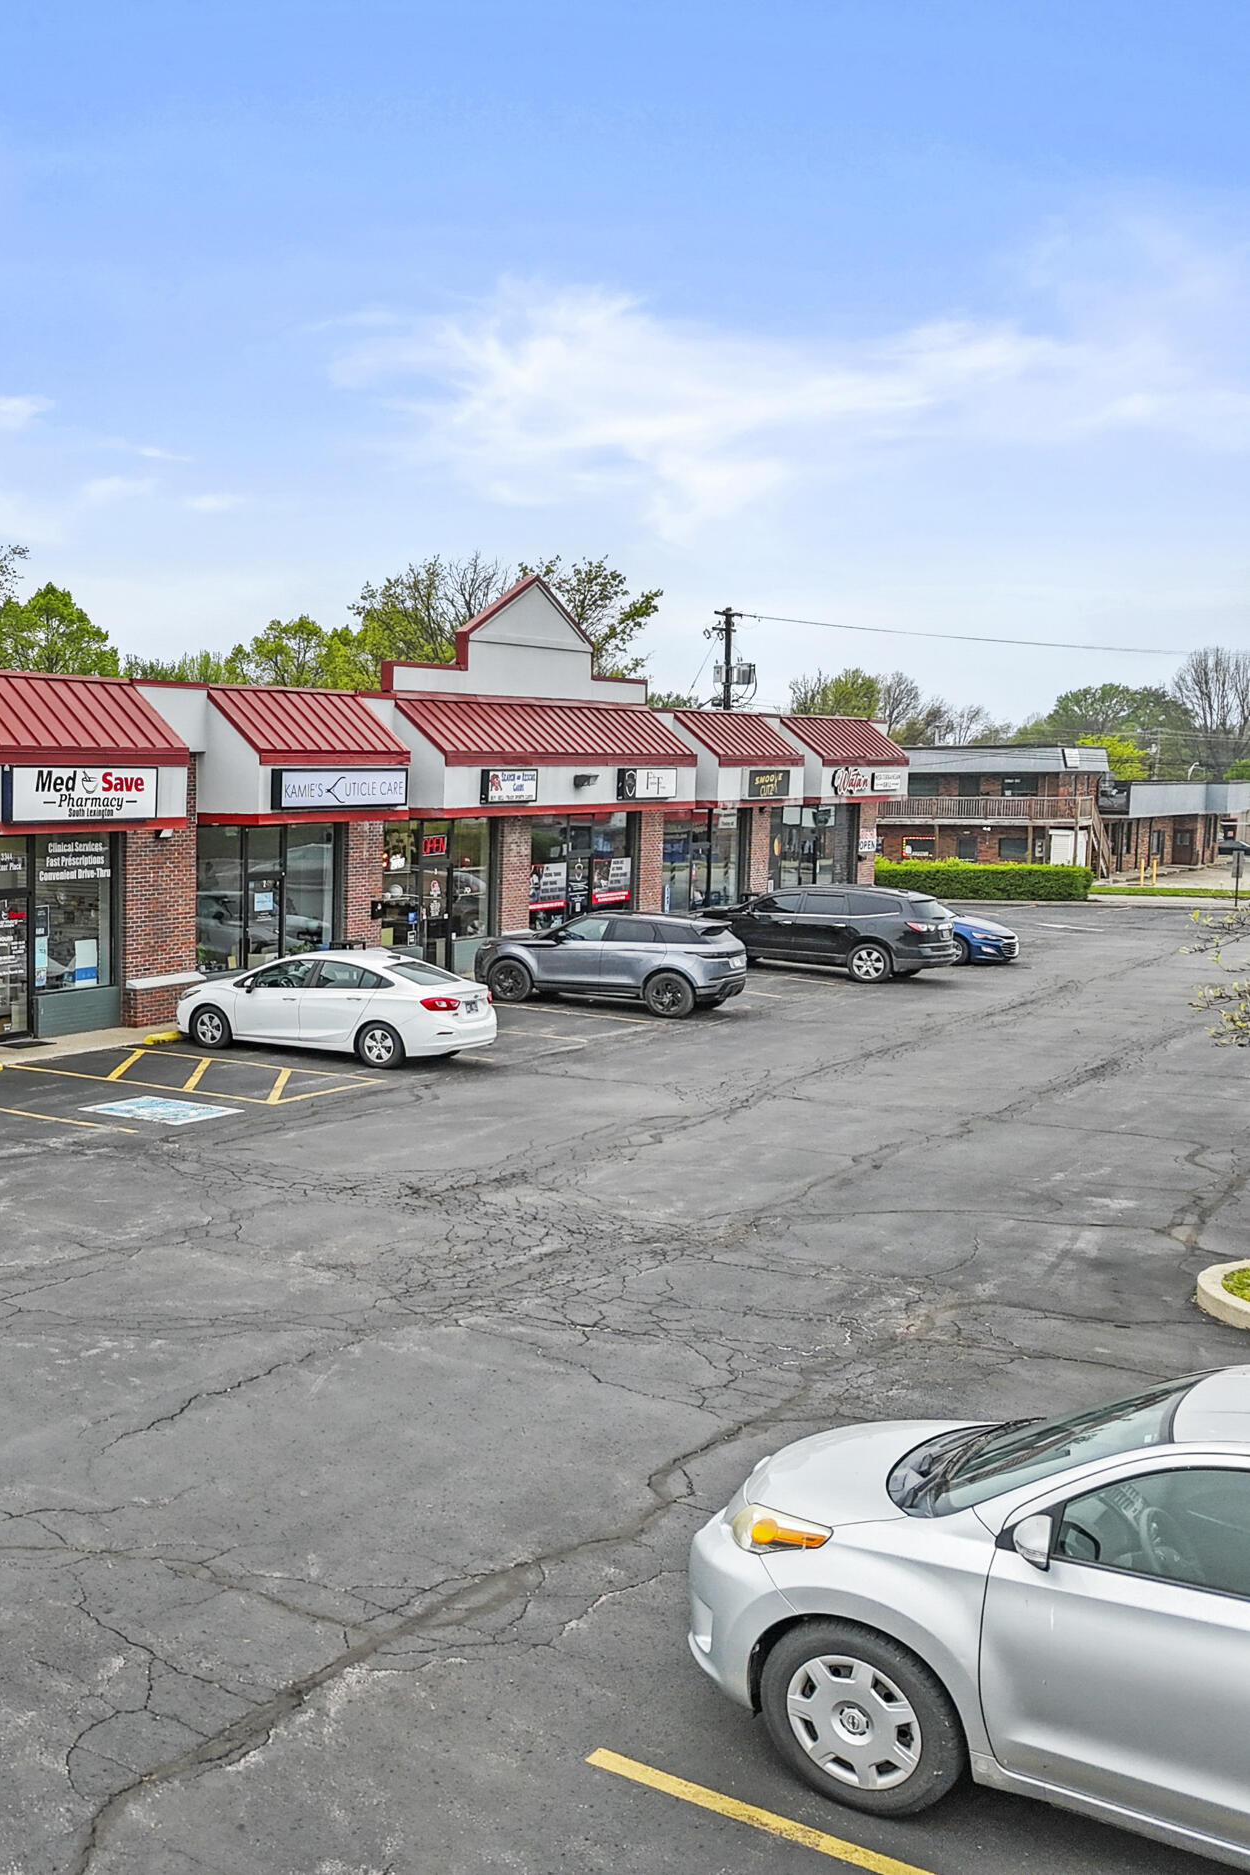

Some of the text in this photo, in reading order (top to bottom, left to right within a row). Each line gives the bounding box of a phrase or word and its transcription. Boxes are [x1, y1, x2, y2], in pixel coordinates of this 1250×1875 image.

[35, 770, 144, 792] Med Save
[284, 783, 323, 798] KAMIE'S
[379, 781, 404, 796] CARE
[58, 794, 124, 811] Pharmacy
[68, 808, 114, 819] South Lexington
[48, 841, 102, 853] Clinical Services
[422, 837, 447, 854] OPEN
[860, 840, 875, 850] OPEN
[46, 855, 104, 867] Fast Prescriptions
[39, 868, 110, 881] Convenient Drive-Thru
